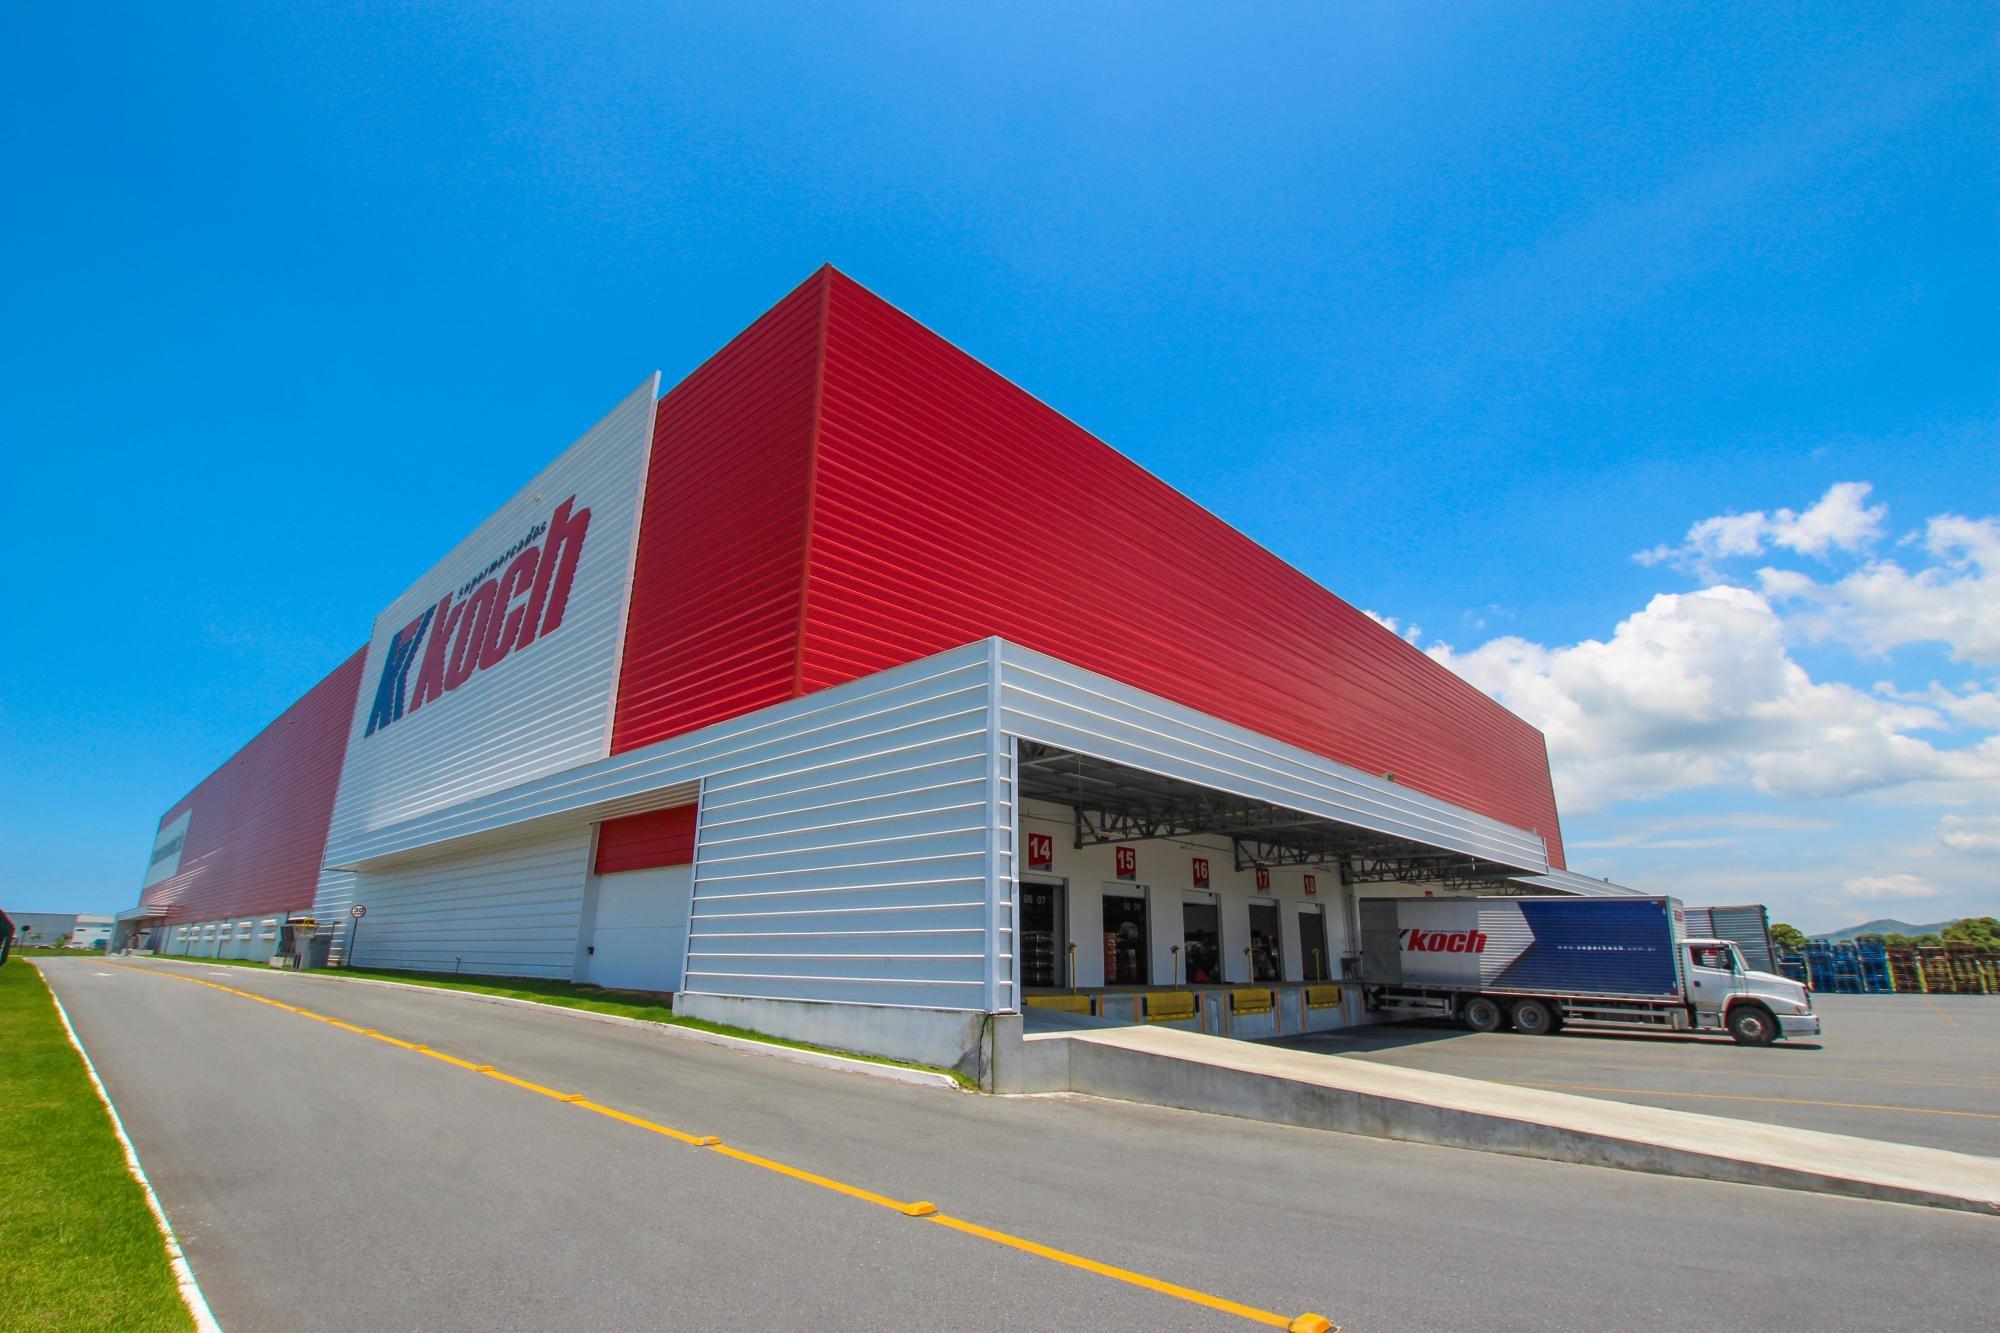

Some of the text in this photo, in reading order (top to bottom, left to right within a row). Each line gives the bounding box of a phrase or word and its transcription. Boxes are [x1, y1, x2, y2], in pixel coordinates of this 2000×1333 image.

[1031, 838, 1050, 859] 14
[1118, 850, 1134, 869] 15
[1194, 862, 1208, 878] 16
[1257, 870, 1268, 886] 17
[1304, 878, 1315, 893] 18
